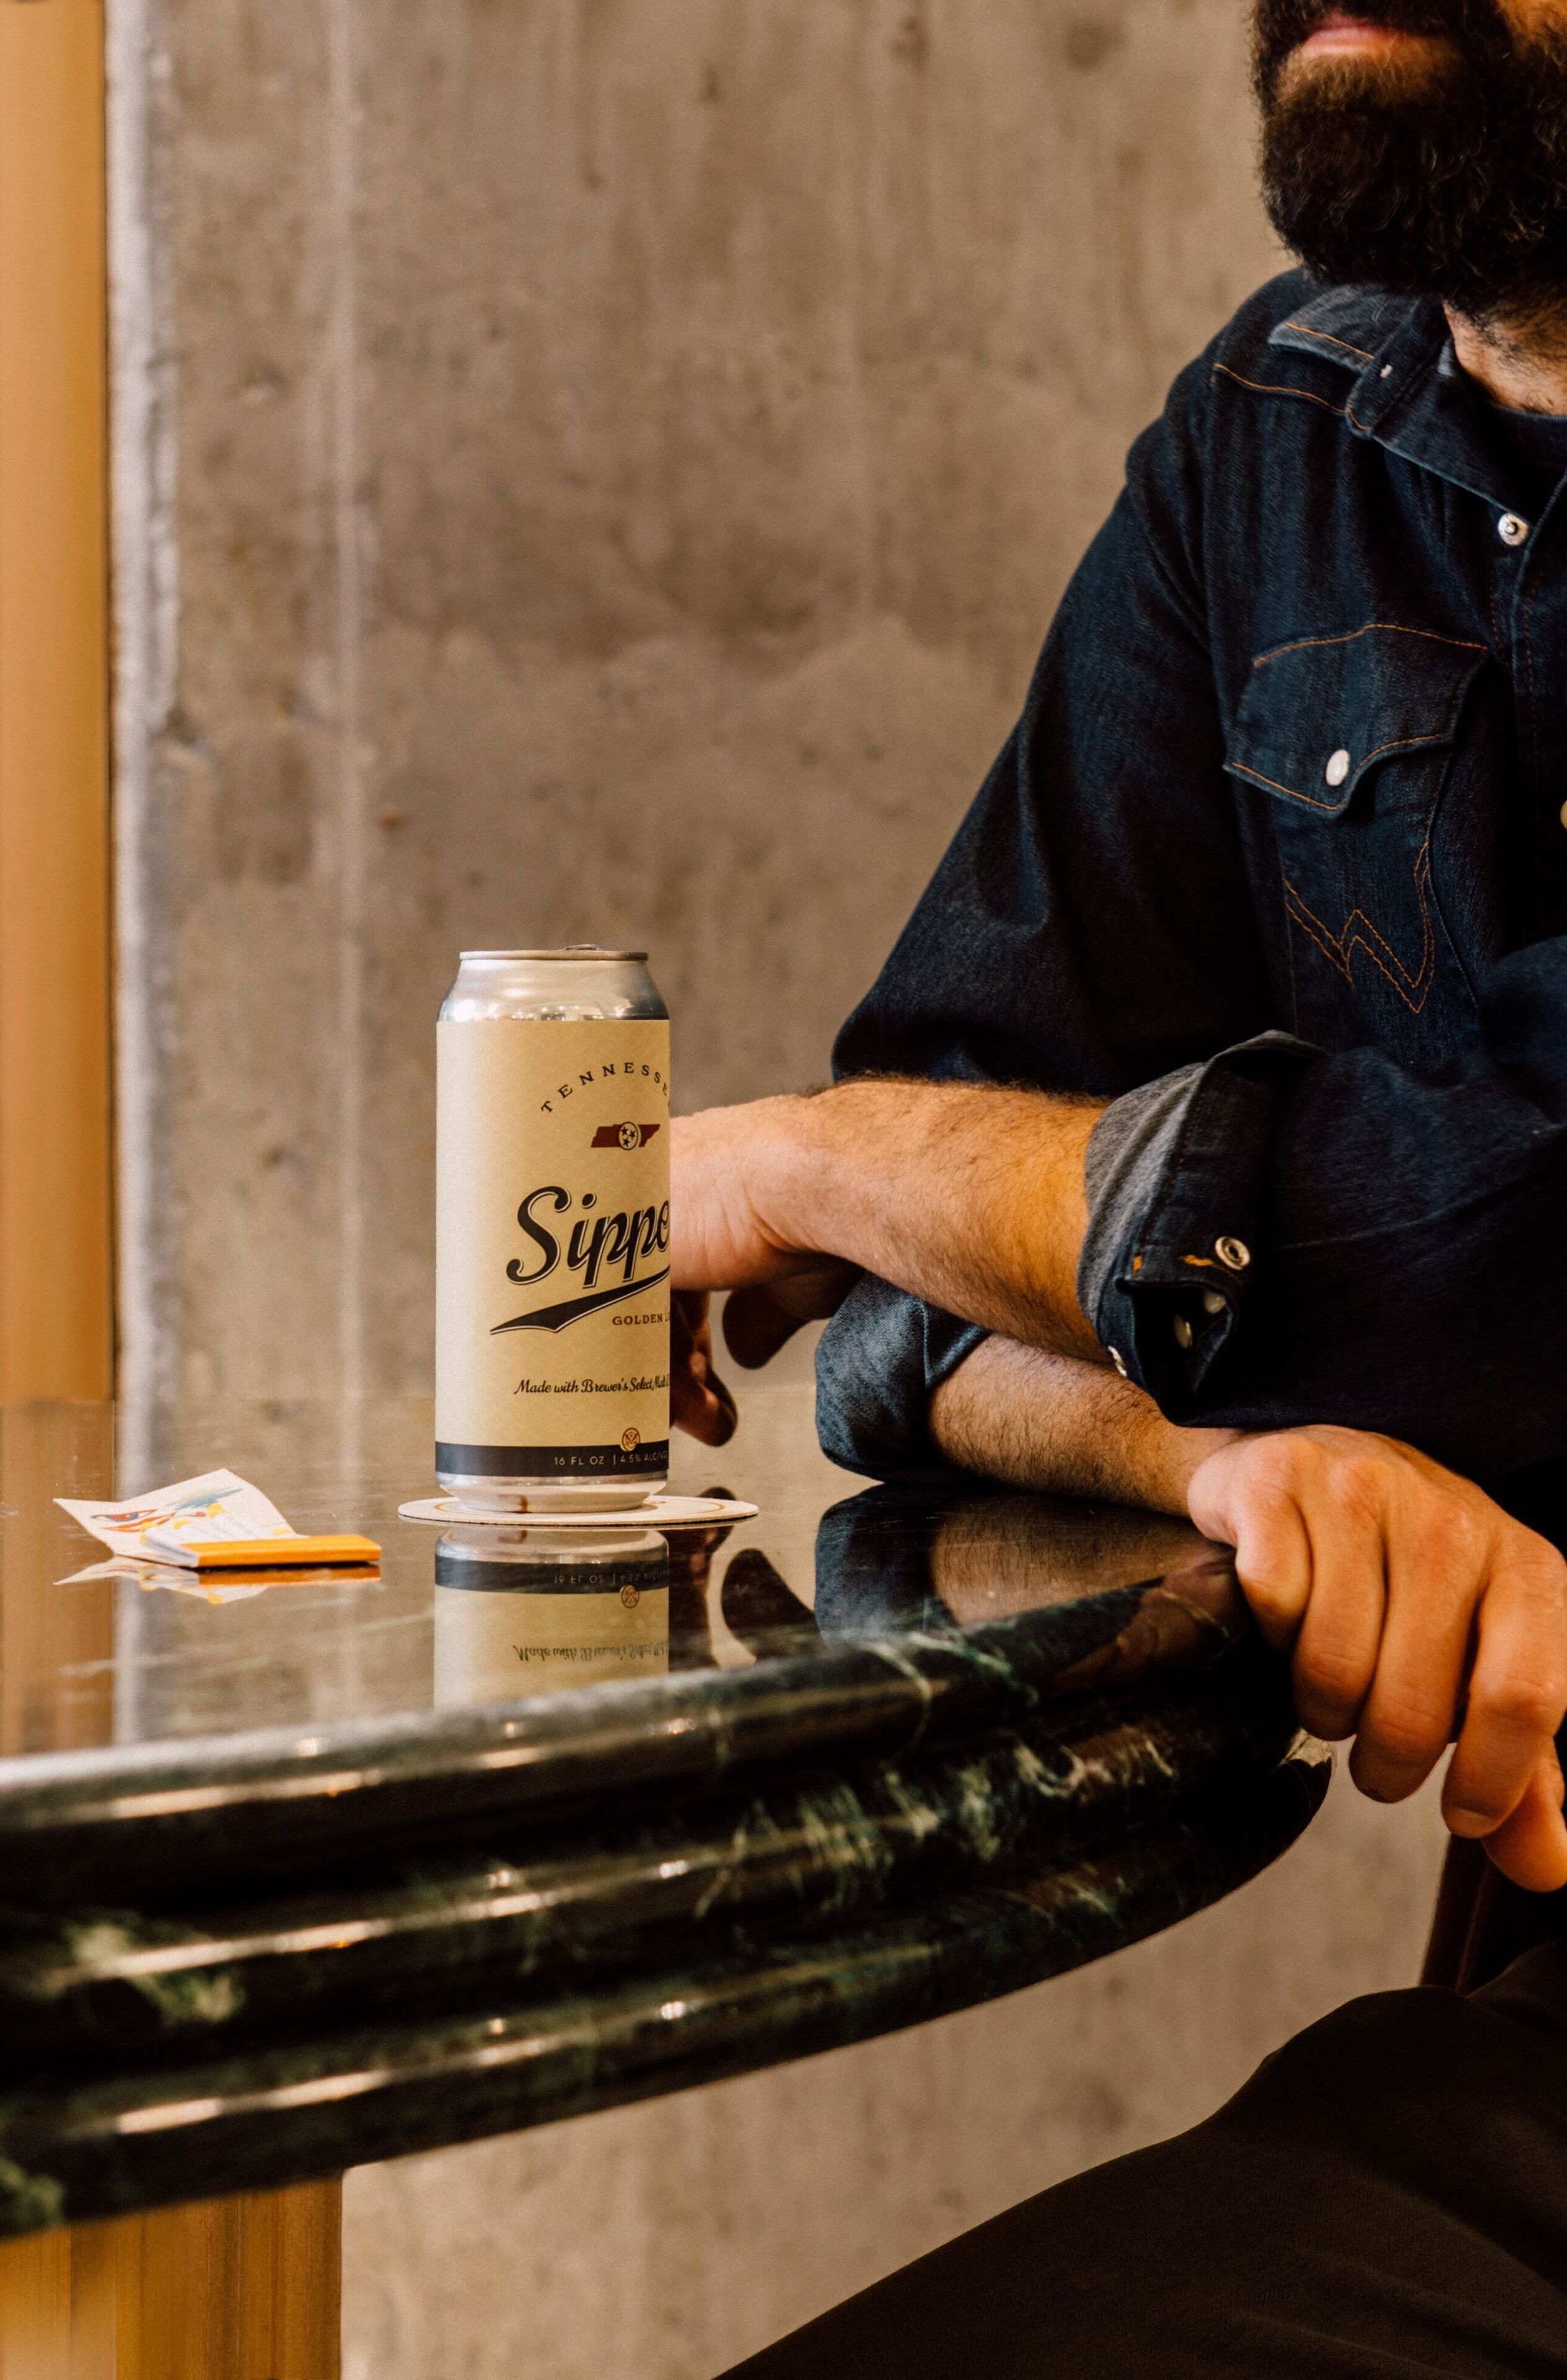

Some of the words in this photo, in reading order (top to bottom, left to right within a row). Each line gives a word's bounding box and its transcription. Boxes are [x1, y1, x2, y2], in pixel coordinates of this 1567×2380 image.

[540, 1062, 670, 1113] TENNESSE
[612, 1313, 663, 1326] GOLDEN
[513, 1379, 552, 1395] Made
[554, 1380, 579, 1393] with
[581, 1378, 629, 1393] Brewer's
[555, 1457, 565, 1466] 16
[571, 1457, 584, 1466] FL
[590, 1456, 605, 1465] OZ
[620, 1454, 641, 1463] 4.5%
